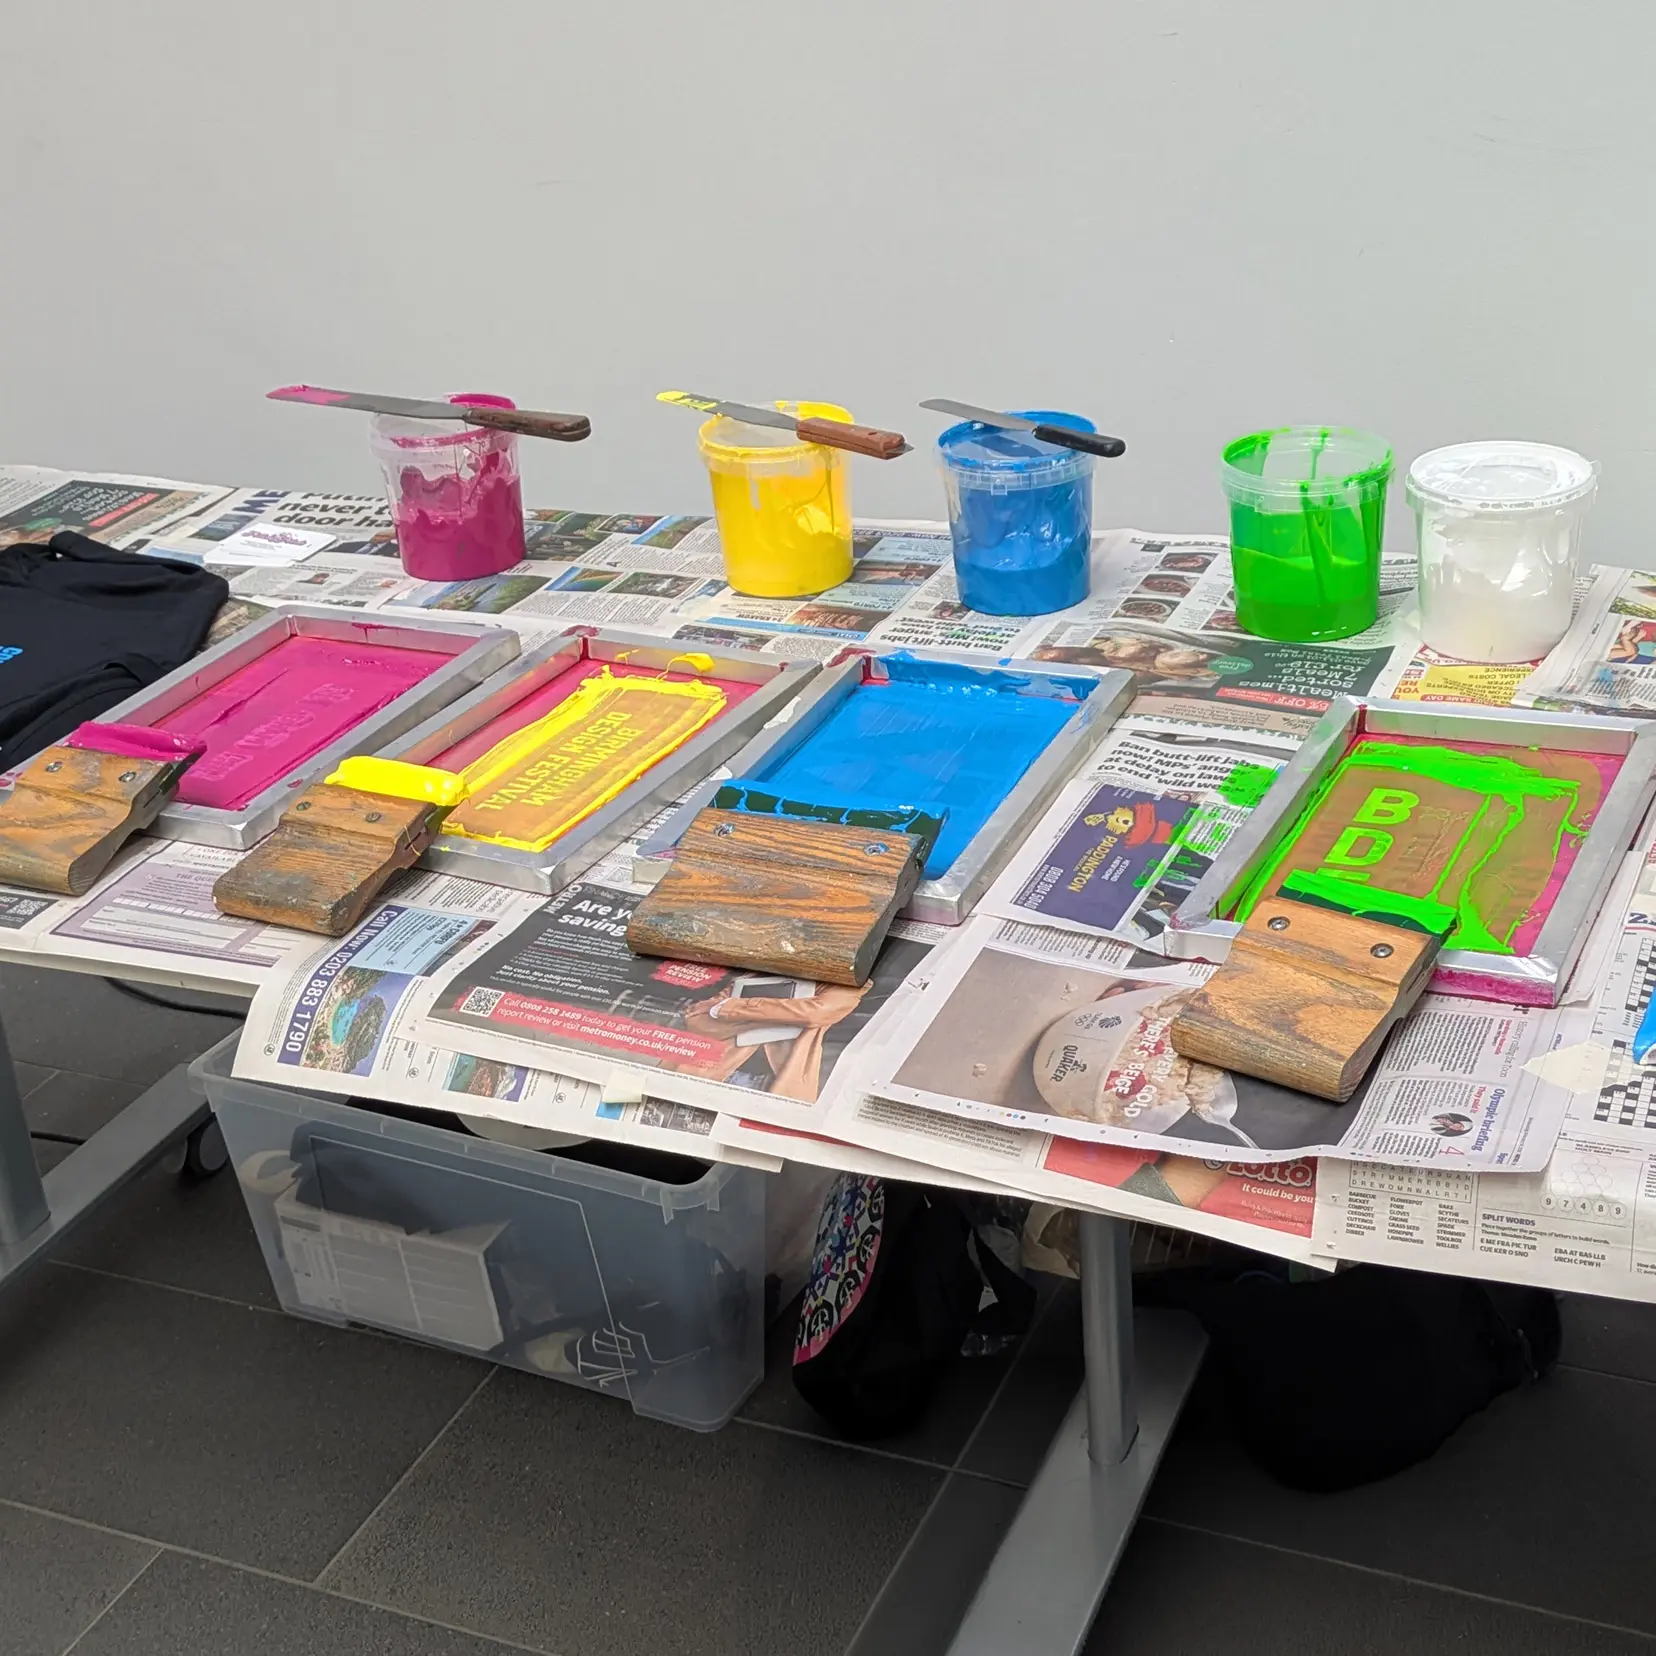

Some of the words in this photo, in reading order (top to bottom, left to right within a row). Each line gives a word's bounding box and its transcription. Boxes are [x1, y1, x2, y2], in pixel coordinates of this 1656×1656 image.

[277, 501, 372, 514] never
[272, 512, 353, 527] door
[1267, 674, 1355, 688] sorted...
[1281, 668, 1344, 678] Meals
[1238, 680, 1348, 699] Mealtimes
[559, 711, 633, 754] DESIGN
[1117, 740, 1151, 753] Ban
[1151, 748, 1221, 764] butt-lift
[1220, 756, 1261, 770] jabs
[520, 727, 646, 806] BIRMINGHAM
[1122, 766, 1151, 780] end
[1124, 757, 1172, 776] delay
[1176, 770, 1196, 779] on
[474, 754, 570, 811] FESTIVAL
[1352, 787, 1420, 825] B
[1323, 826, 1394, 866] D
[1067, 835, 1118, 893] PADDINGTON
[542, 884, 583, 914] METRO
[571, 899, 613, 916] Are
[373, 910, 398, 930] Call
[558, 914, 628, 937] saving
[318, 951, 353, 977] 0203
[668, 964, 713, 980] PENSION
[665, 969, 705, 983] REVIEW
[301, 978, 328, 1007] 883
[286, 1010, 312, 1052] 1790
[496, 1007, 526, 1020] report
[523, 1012, 552, 1025] review
[551, 1018, 562, 1027] or
[562, 1021, 581, 1032] visit
[580, 1023, 697, 1057] metromoney.co.uk/review
[503, 997, 520, 1007] Call
[542, 1005, 560, 1016] 258
[560, 1009, 582, 1019] 1489
[581, 1014, 605, 1027] today
[606, 1019, 617, 1028] to
[615, 1022, 632, 1033] get
[631, 1026, 651, 1037] your
[652, 1030, 677, 1041] FREE
[675, 1036, 712, 1049] pension
[1049, 1043, 1079, 1083] QUAKER
[1112, 1061, 1145, 1096] BEIGE
[1124, 1084, 1157, 1118] GOLD
[1485, 1088, 1506, 1121] Olympic
[1471, 1119, 1495, 1152] briefing
[1242, 1183, 1251, 1192] It
[1251, 1184, 1280, 1198] could
[1280, 1190, 1294, 1200] be
[1293, 1194, 1315, 1204] you
[1389, 1209, 1410, 1217] GLOVES
[1546, 1197, 1552, 1205] 9
[1563, 1200, 1569, 1208] 7
[1580, 1202, 1586, 1210] 4
[1598, 1204, 1604, 1212] 8
[1615, 1207, 1621, 1215] 9
[1481, 1213, 1505, 1224] SPLIT
[1505, 1215, 1536, 1227] WORDS
[1436, 1235, 1463, 1244] TOOLBOX
[1496, 1225, 1519, 1234] together
[1528, 1229, 1547, 1238] groups
[1578, 1235, 1593, 1243] build
[1514, 1250, 1529, 1258] SNO
[1554, 1256, 1573, 1264] URCH
[1579, 1259, 1595, 1267] PEW
[1568, 1249, 1578, 1257] AT
